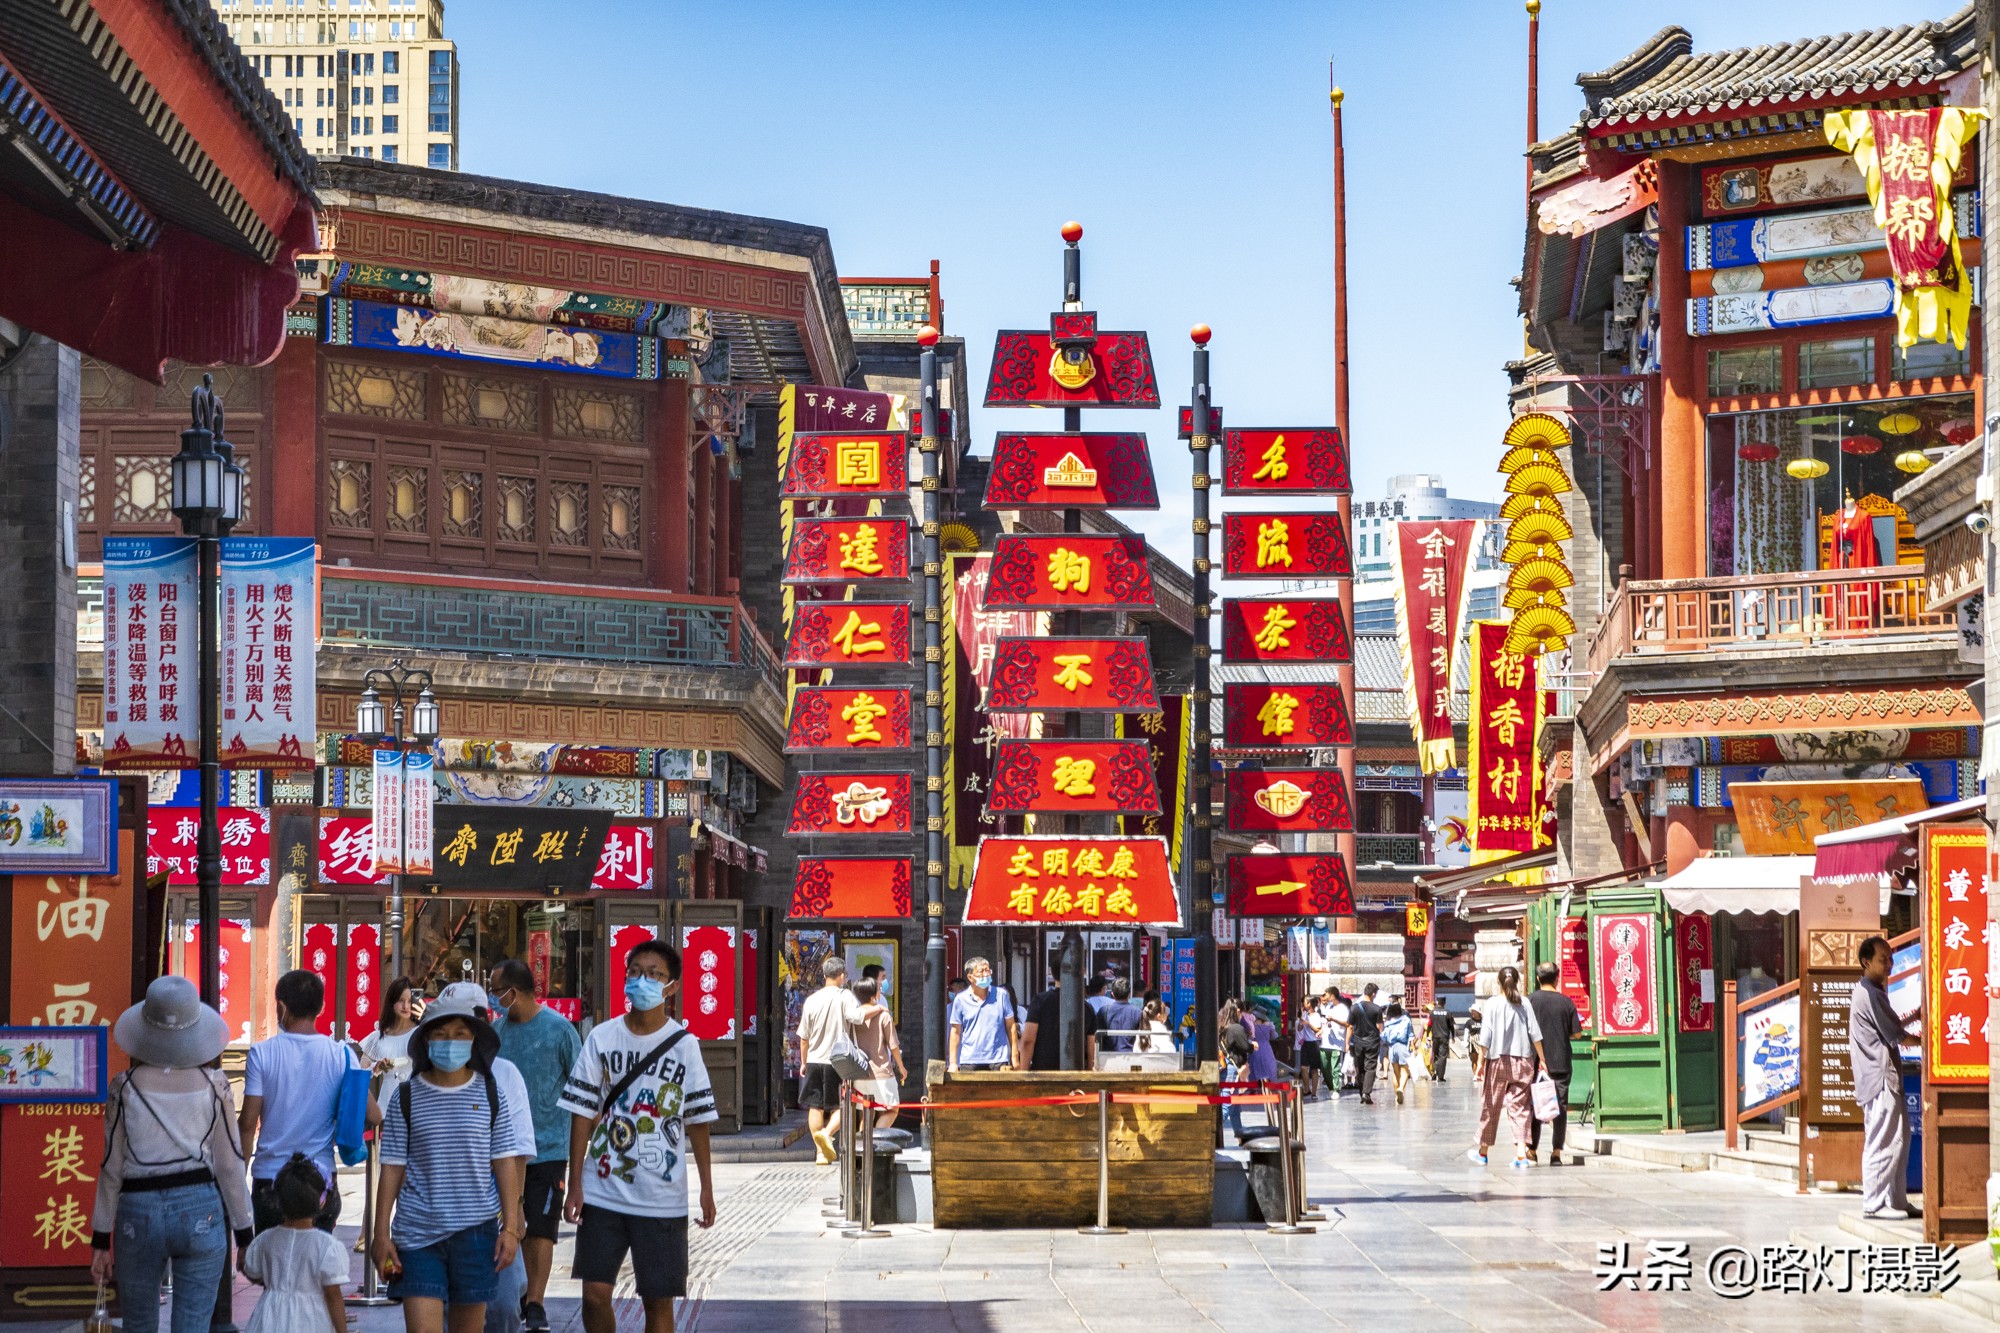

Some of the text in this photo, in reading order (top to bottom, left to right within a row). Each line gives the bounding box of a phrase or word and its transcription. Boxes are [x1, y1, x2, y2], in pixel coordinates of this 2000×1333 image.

[1882, 109, 1934, 252] 糖帮
[804, 392, 878, 424] 百年老店
[1253, 434, 1289, 480] 名
[1257, 519, 1293, 568] 流
[1048, 547, 1091, 593] 狗
[128, 583, 147, 721] 泼水降温等救援
[159, 583, 178, 721] 阳台窗户快呼救
[833, 610, 885, 655] 仁
[1255, 604, 1296, 651] 茶
[244, 584, 265, 722] 用火千万别离人
[273, 583, 293, 722] 熄火断电关燃气
[1053, 653, 1093, 692] 不
[841, 692, 887, 743] 堂
[1488, 649, 1525, 804] 稻香村
[1052, 755, 1096, 797] 理
[1479, 815, 1532, 832] 中华老字号
[594, 832, 643, 884] 刺
[1007, 845, 1138, 879] 文明健康
[1007, 883, 1138, 917] 有你有我
[1412, 911, 1425, 929] 茶
[1616, 924, 1635, 1026] 津门老店
[1943, 868, 1974, 1045] 董家面塑
[33, 1125, 97, 1250] 装裱
